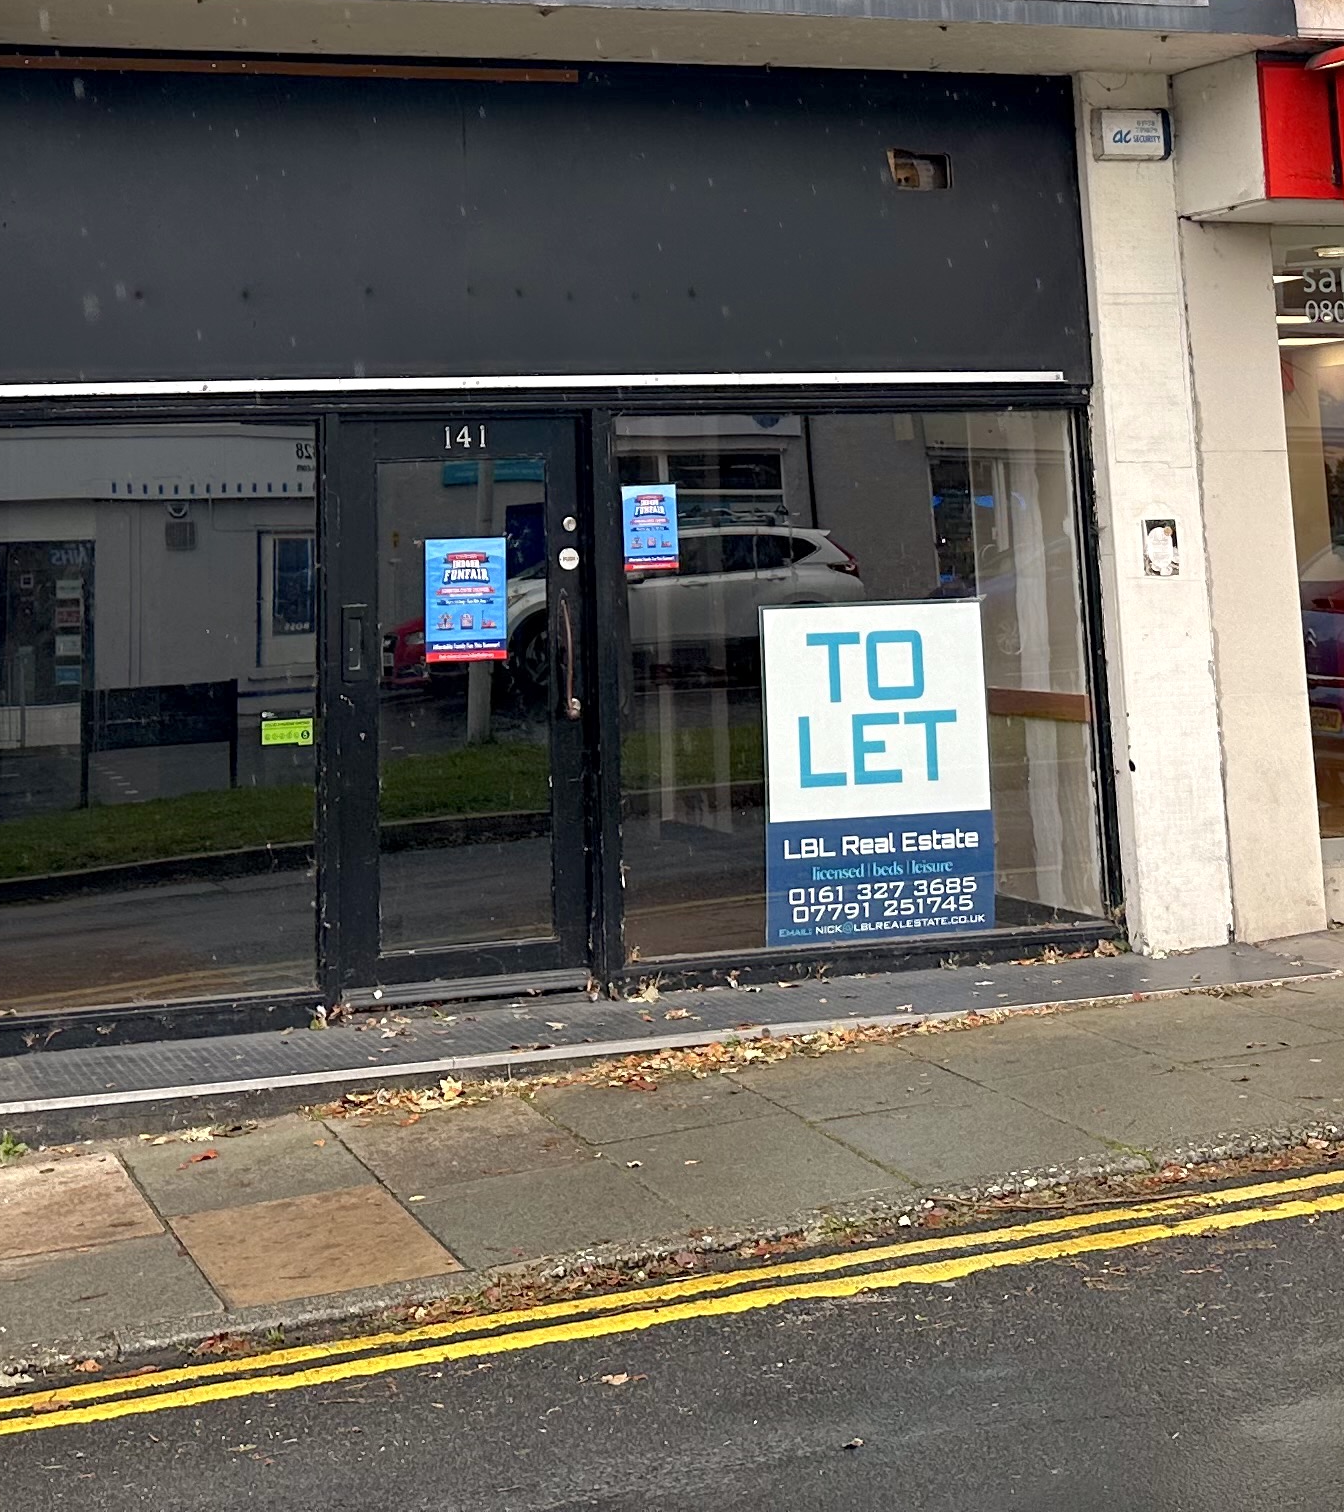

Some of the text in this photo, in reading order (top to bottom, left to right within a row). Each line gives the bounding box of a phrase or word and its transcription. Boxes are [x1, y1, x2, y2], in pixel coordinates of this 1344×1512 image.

[444, 424, 486, 449] 141
[444, 568, 489, 583] FUNFAIR
[805, 629, 926, 703] TO
[796, 709, 957, 789] LET
[783, 828, 979, 860] LBL Real Estate
[811, 859, 954, 882] licensed beds leisure
[788, 876, 978, 906] 0161 327 3685
[792, 894, 974, 924] 07791 251745
